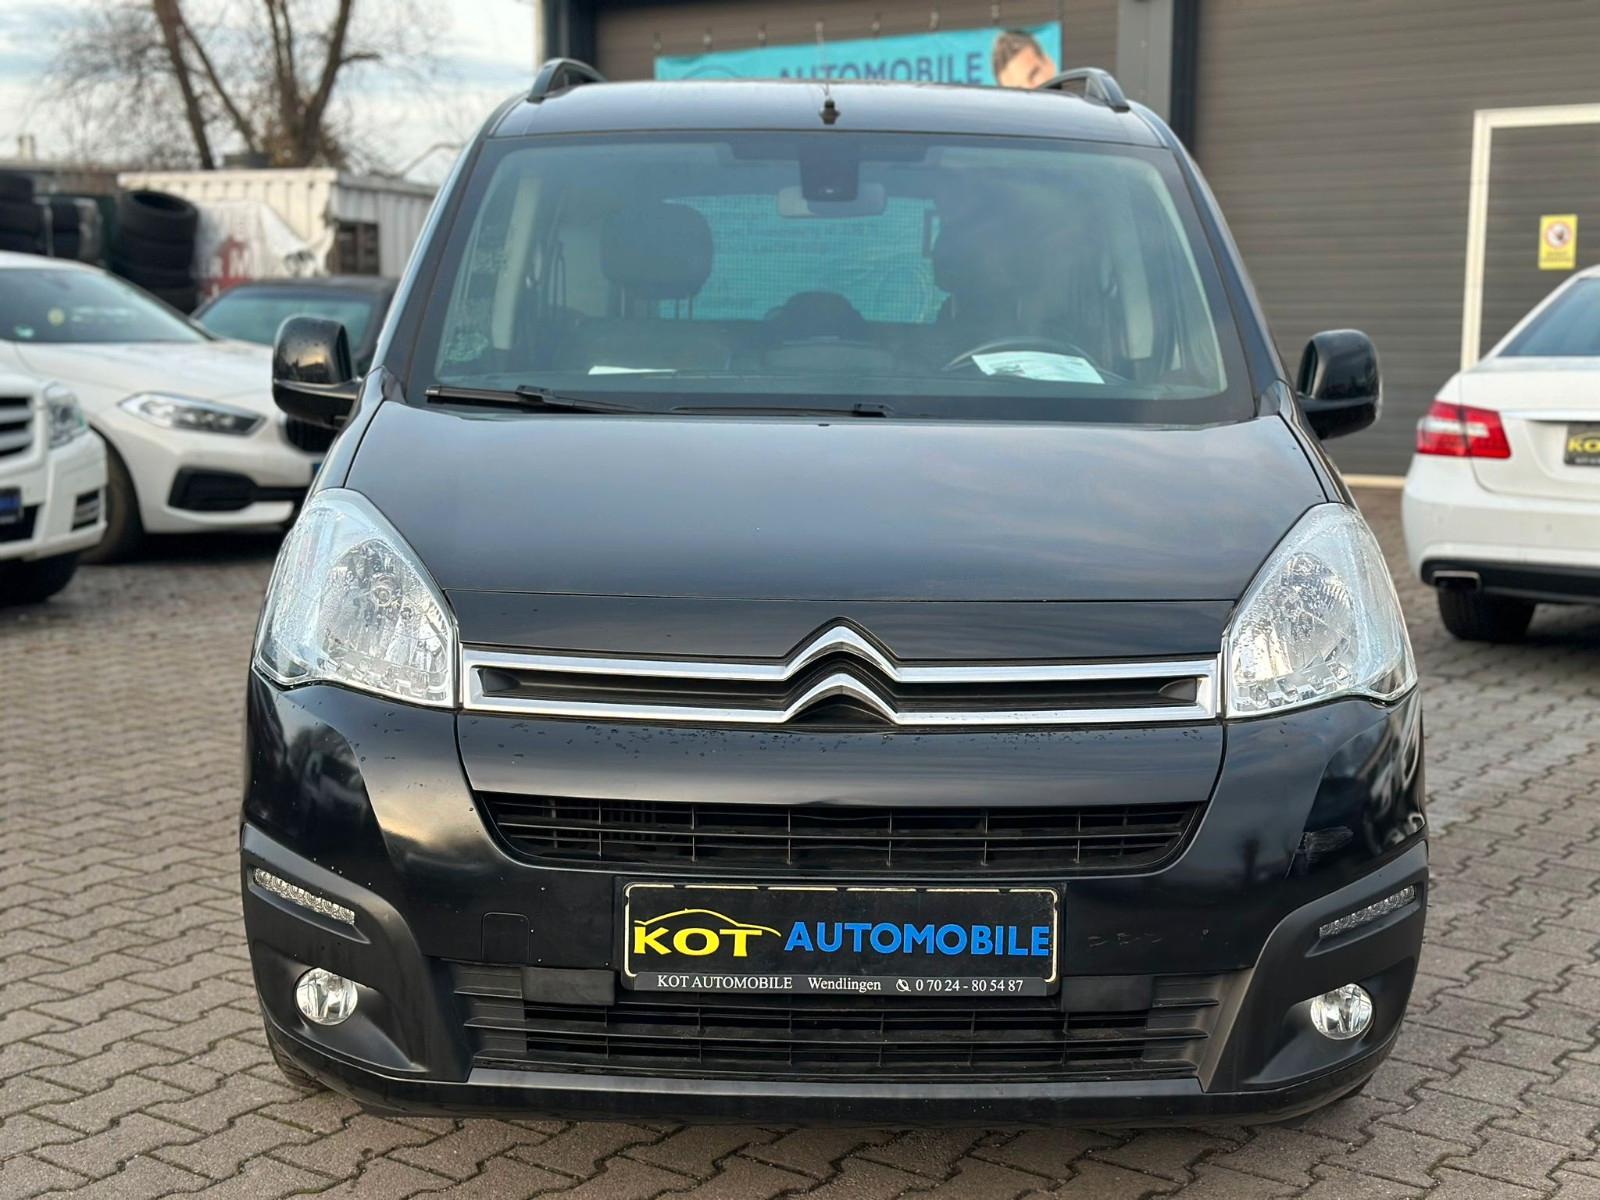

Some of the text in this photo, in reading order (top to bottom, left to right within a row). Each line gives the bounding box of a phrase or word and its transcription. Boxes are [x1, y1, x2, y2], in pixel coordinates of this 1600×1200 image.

[633, 921, 1050, 957] KOT AUTOMOBILE
[657, 975, 689, 988] KOT
[692, 976, 793, 990] AUTOMOBILE
[808, 977, 882, 994] Wendlingen
[915, 979, 924, 992] 0
[926, 979, 942, 992] 70
[944, 979, 960, 992] 24
[971, 979, 987, 992] 80
[989, 979, 1005, 992] 54
[1008, 979, 1024, 992] 87
